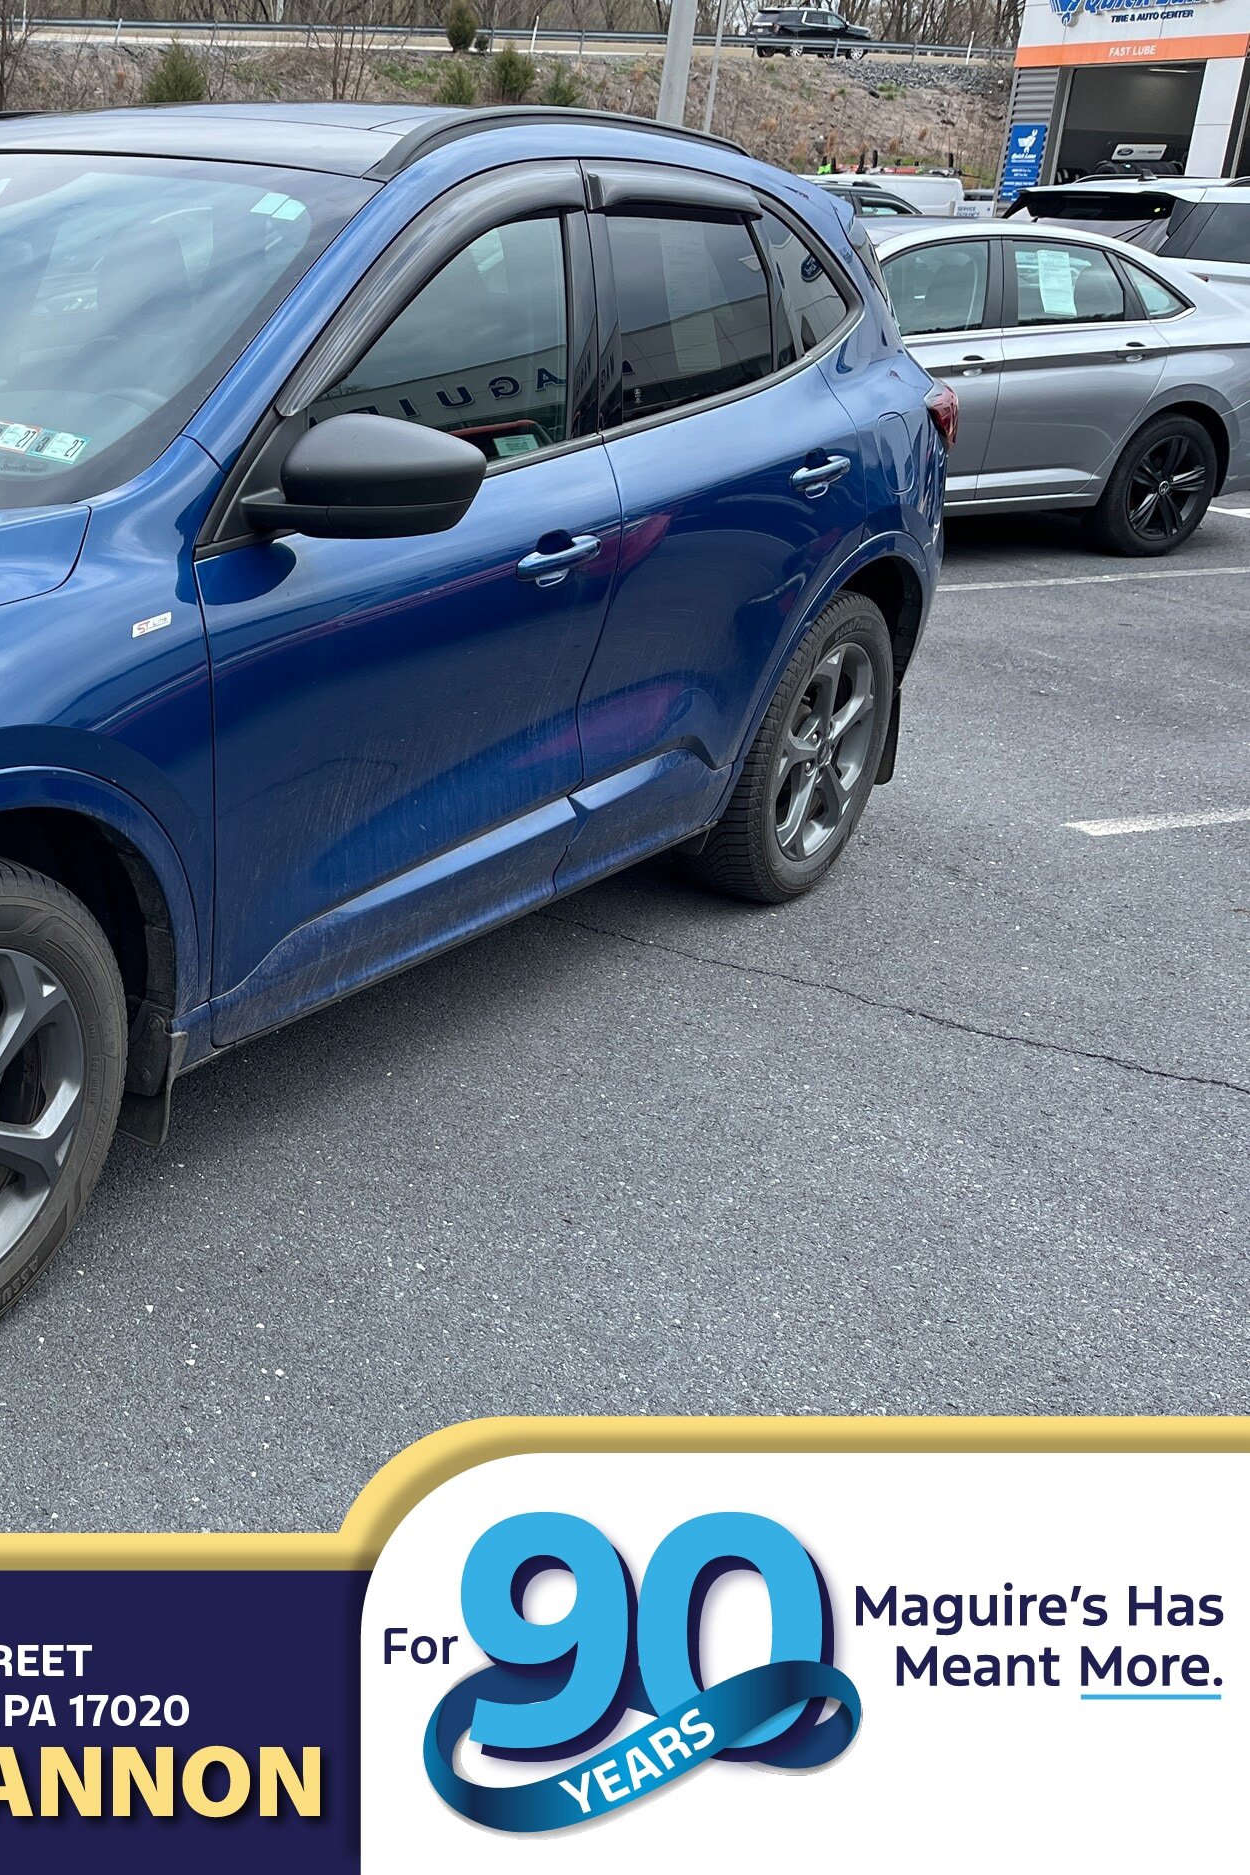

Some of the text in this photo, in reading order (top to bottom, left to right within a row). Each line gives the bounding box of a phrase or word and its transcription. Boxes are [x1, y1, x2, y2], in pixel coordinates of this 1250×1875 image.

[1111, 9, 1194, 23] TIRE & AUTO CENTER
[1108, 45, 1157, 58] FAST LUBE
[14, 429, 37, 449] 27
[63, 439, 86, 459] 27
